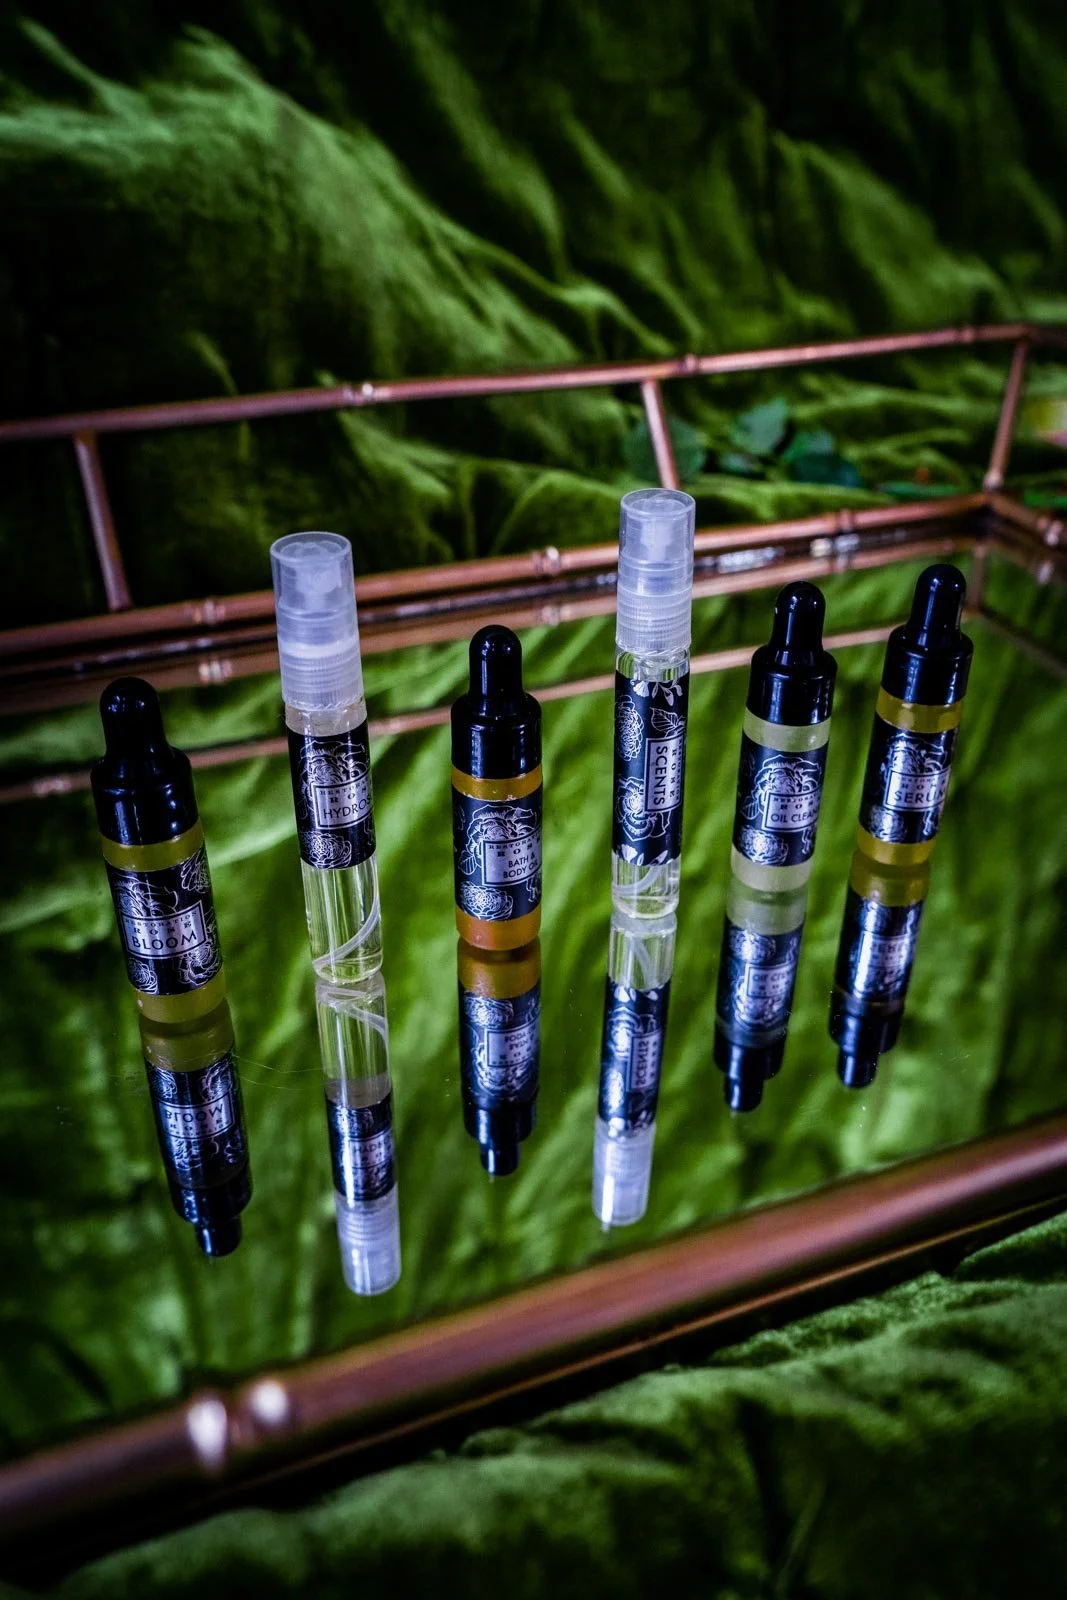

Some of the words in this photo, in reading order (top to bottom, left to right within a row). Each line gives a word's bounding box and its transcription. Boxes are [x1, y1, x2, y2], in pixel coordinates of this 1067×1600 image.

[653, 745, 668, 806] SCENTS
[770, 812, 788, 824] OIL
[508, 855, 529, 869] BATH
[502, 865, 528, 879] BODY
[131, 929, 197, 950] BLOOM
